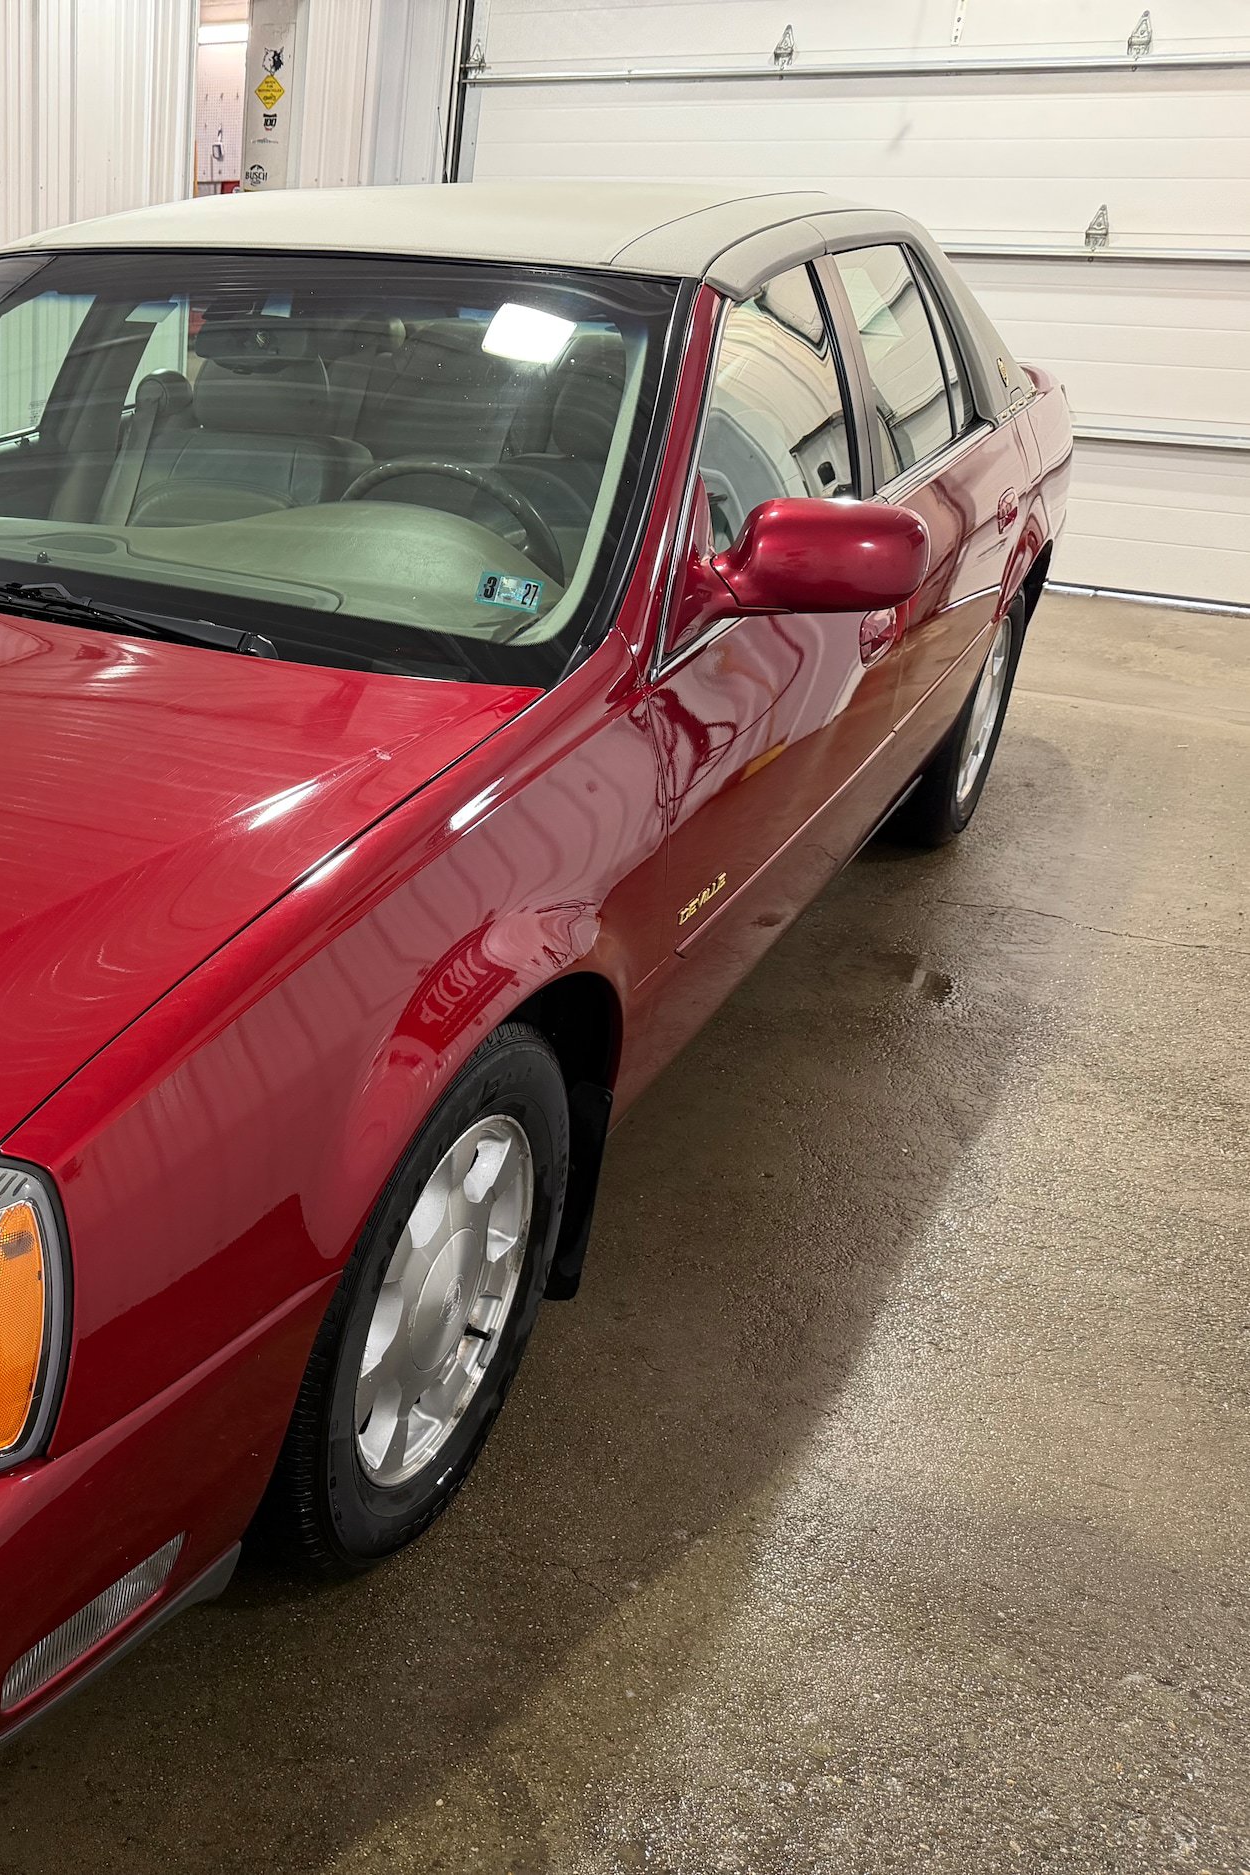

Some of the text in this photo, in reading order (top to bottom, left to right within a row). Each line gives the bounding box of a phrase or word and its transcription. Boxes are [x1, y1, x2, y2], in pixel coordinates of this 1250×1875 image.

[245, 171, 268, 181] BUSCH
[483, 576, 539, 608] 3 27
